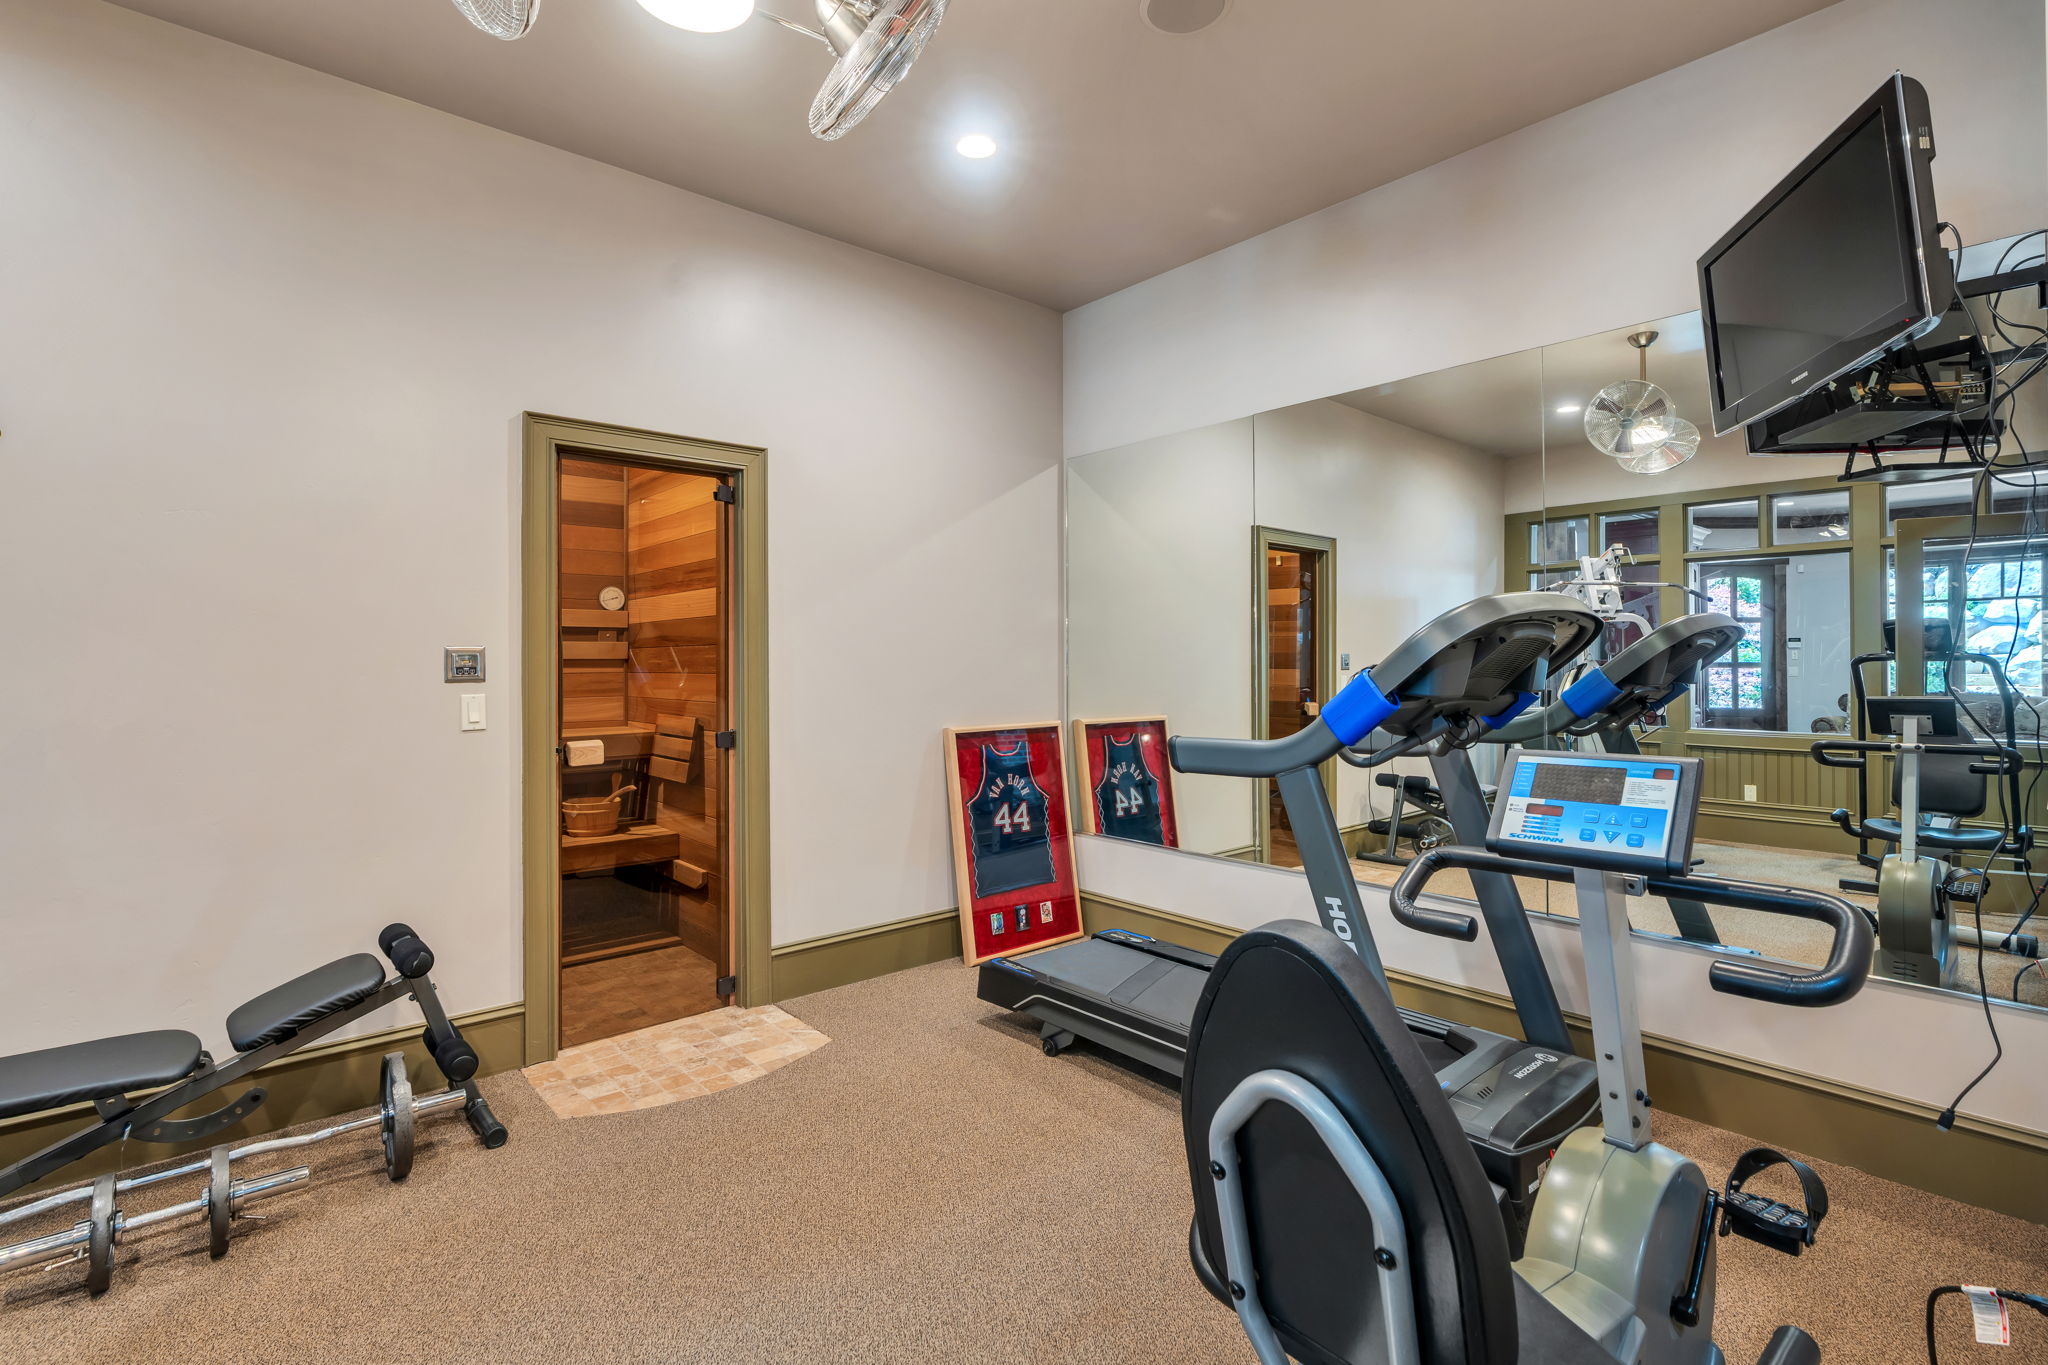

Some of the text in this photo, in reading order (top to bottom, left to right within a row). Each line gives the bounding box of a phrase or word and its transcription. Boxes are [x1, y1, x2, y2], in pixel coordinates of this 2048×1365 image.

[989, 773, 1030, 797] VAN HORN
[993, 799, 1032, 834] 44
[1508, 832, 1564, 843] SCHWINN
[1513, 1058, 1545, 1079] HORIZON
